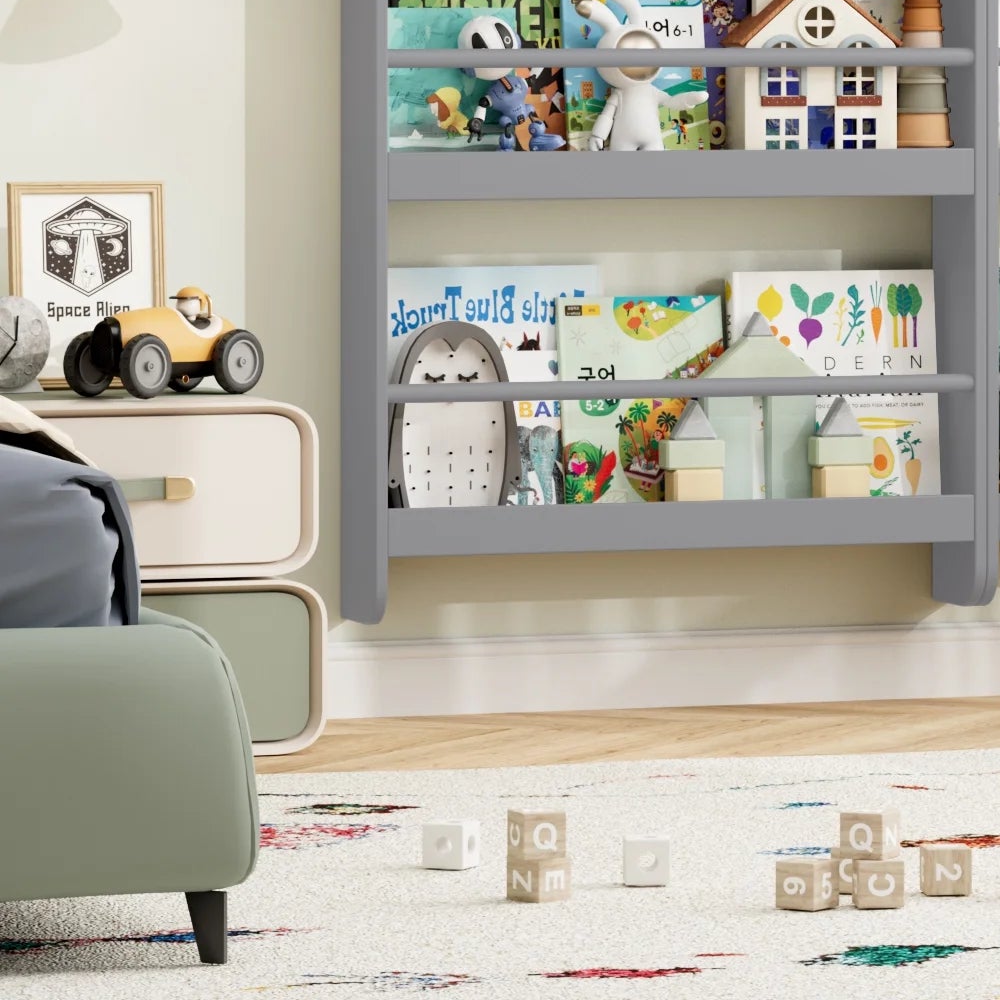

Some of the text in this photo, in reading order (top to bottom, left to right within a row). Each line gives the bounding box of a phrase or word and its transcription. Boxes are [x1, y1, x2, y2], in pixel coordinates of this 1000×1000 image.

[673, 25, 694, 37] 6-1
[47, 301, 131, 322] Space Alien
[801, 354, 923, 371] DERN
[585, 400, 605, 411] 5-2
[532, 822, 559, 851] Q
[849, 822, 874, 854] Q
[935, 862, 963, 882] 2
[821, 871, 833, 899] 5
[867, 873, 896, 897] C
